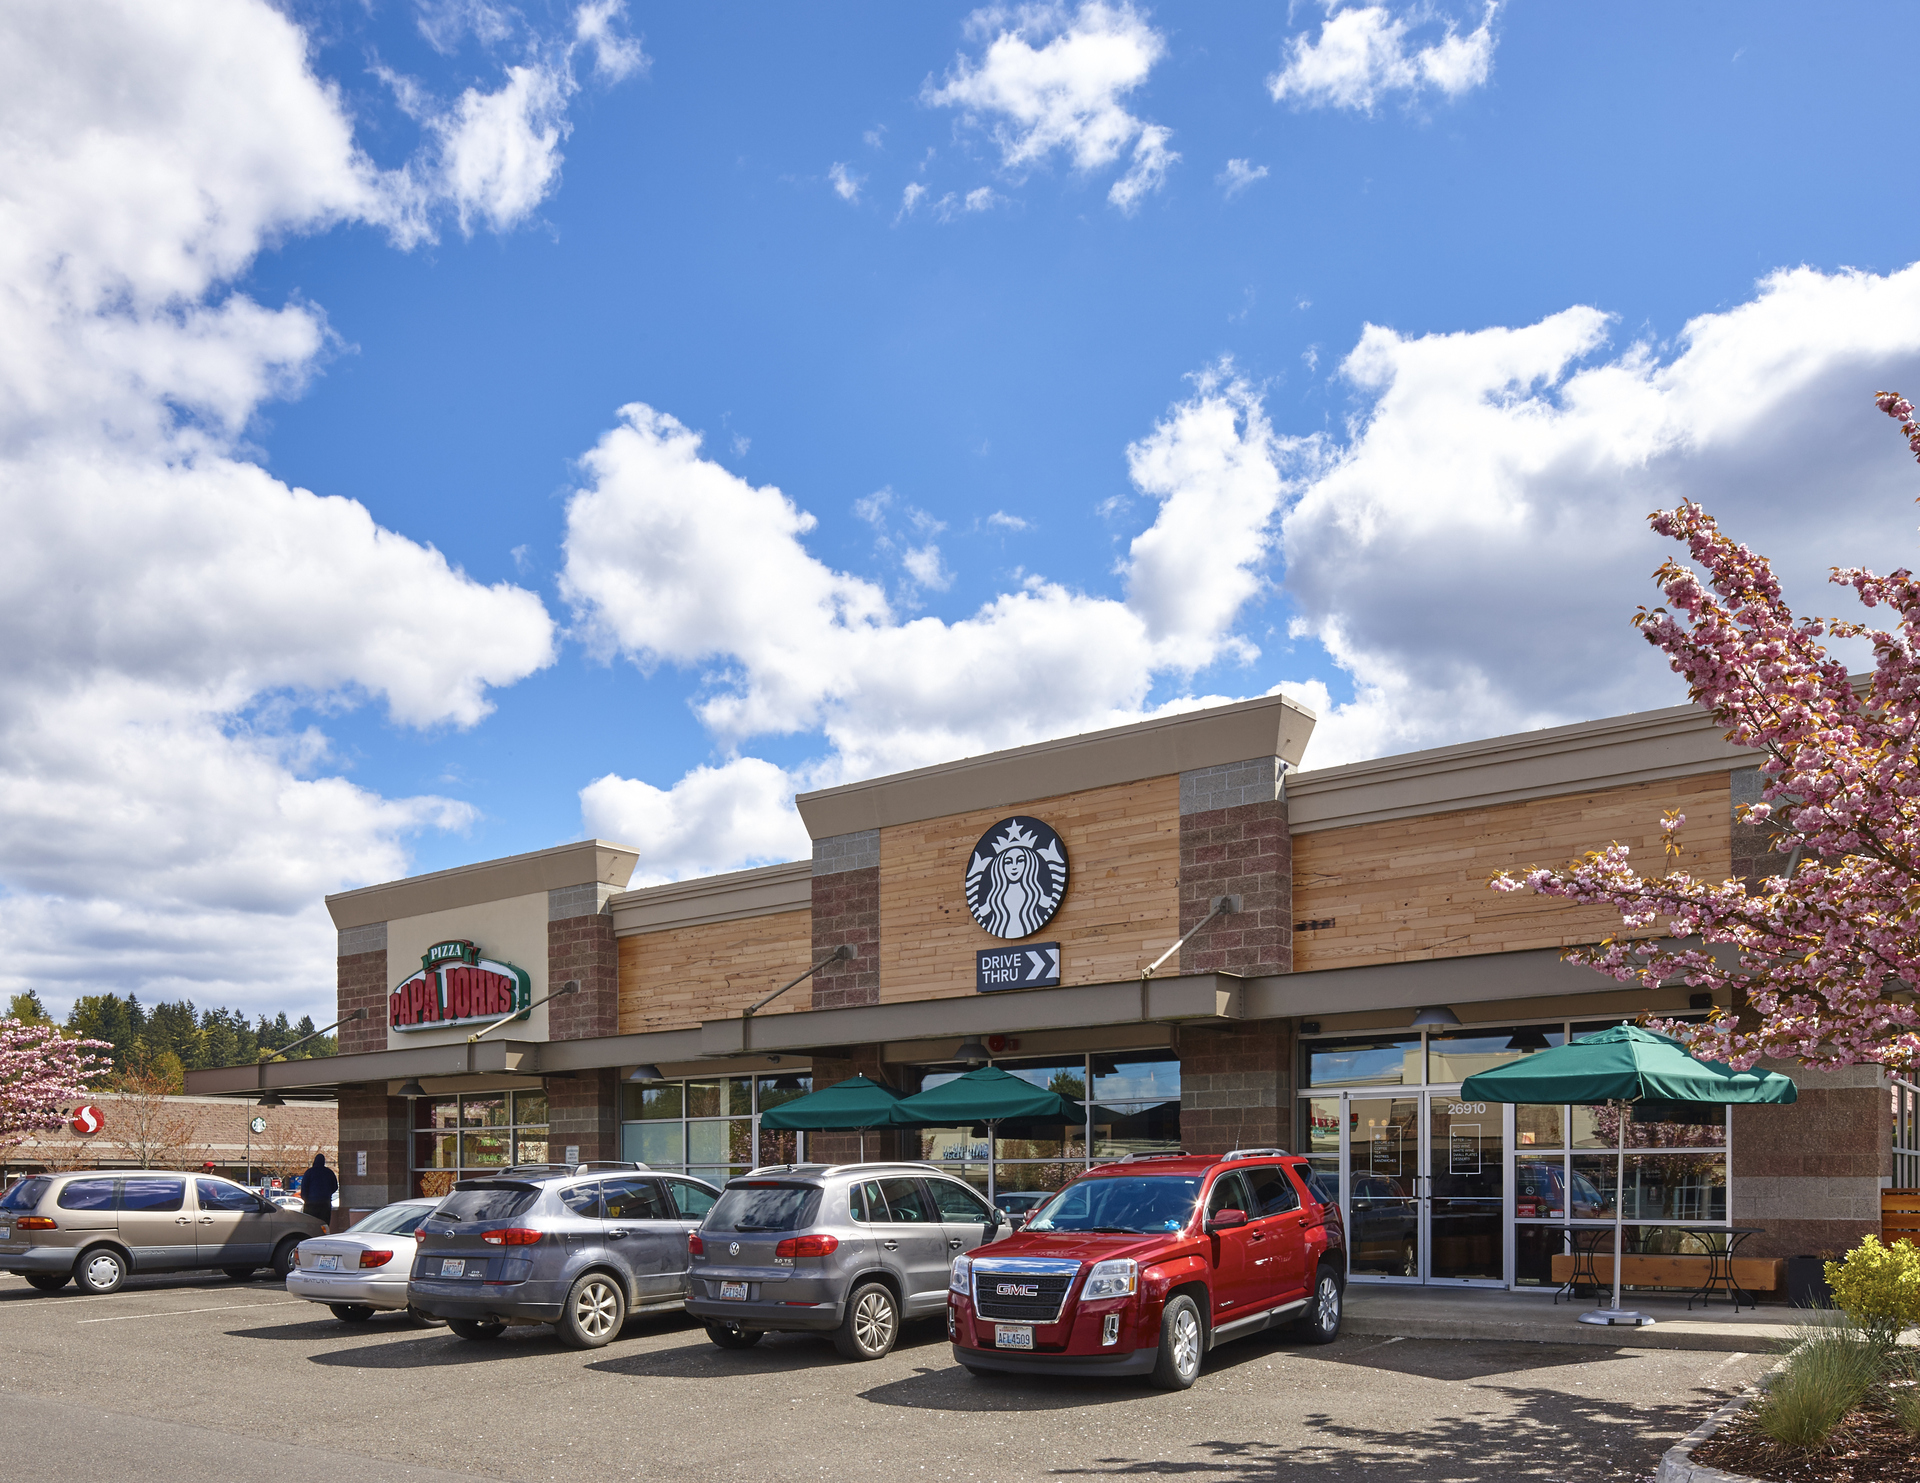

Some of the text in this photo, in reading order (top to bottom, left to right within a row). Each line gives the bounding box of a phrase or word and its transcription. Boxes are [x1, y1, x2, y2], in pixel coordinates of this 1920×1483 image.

[430, 944, 462, 960] PIZZA
[981, 953, 1022, 970] DRIVE
[982, 967, 1019, 984] THRU
[389, 966, 512, 1027] PAPA JOHN'S
[1447, 1102, 1487, 1115] 26910
[996, 1283, 1039, 1297] GMC
[997, 1332, 1031, 1346] AFL4509
